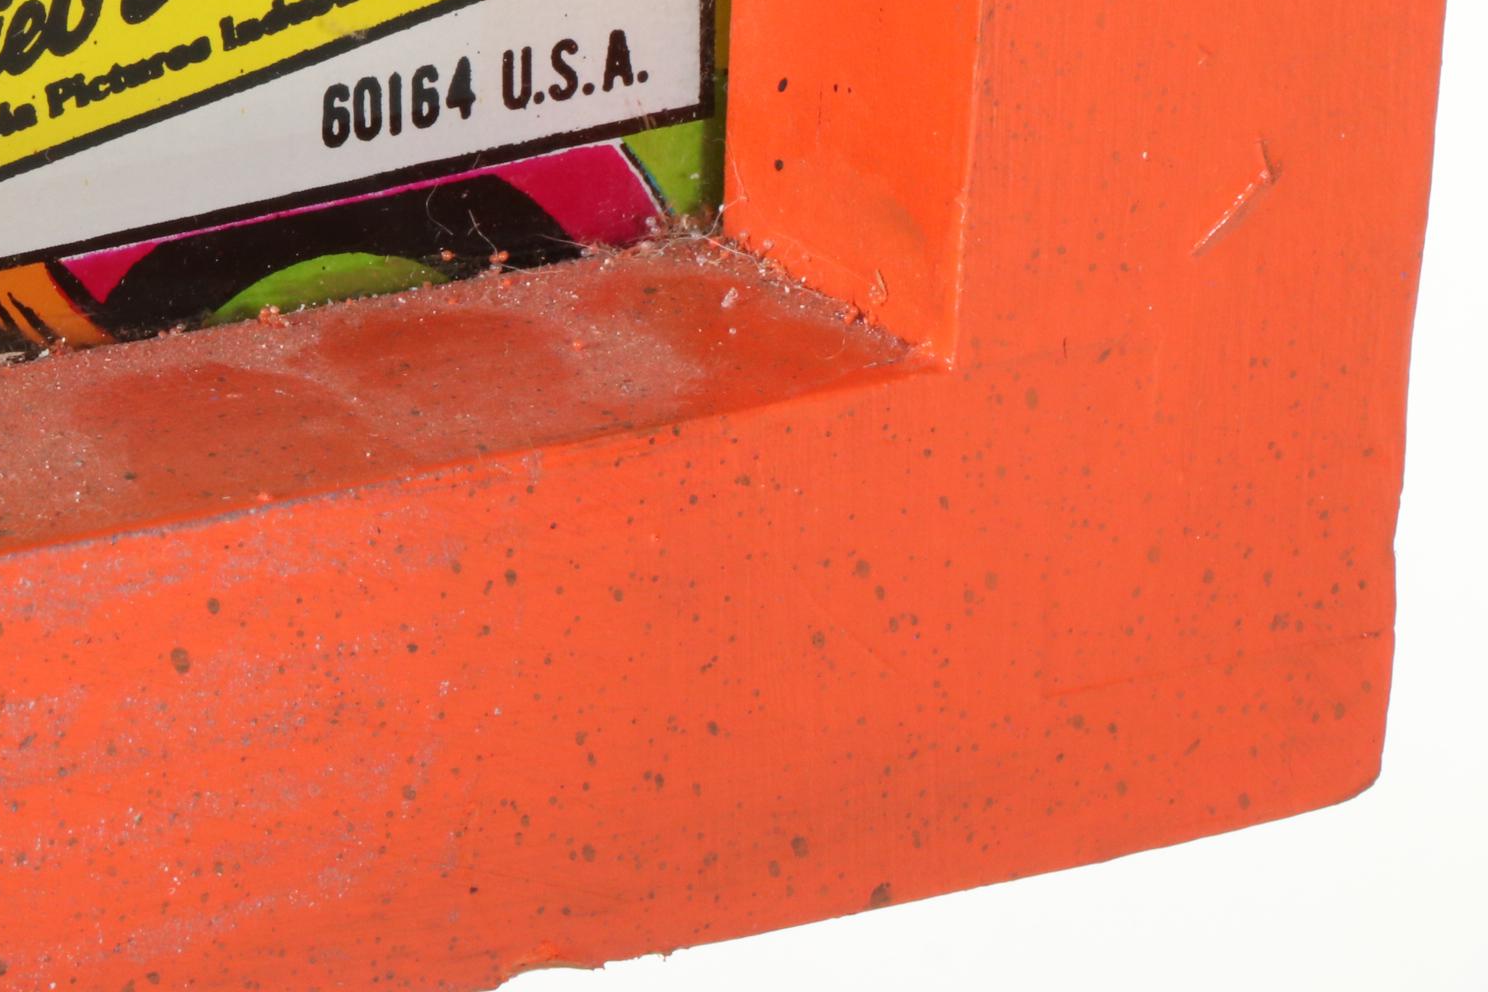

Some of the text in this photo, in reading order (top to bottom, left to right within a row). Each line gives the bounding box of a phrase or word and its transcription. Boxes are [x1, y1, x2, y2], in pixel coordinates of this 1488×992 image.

[45, 35, 212, 118] Pictures
[321, 29, 649, 149] 60164 U.S.A.
